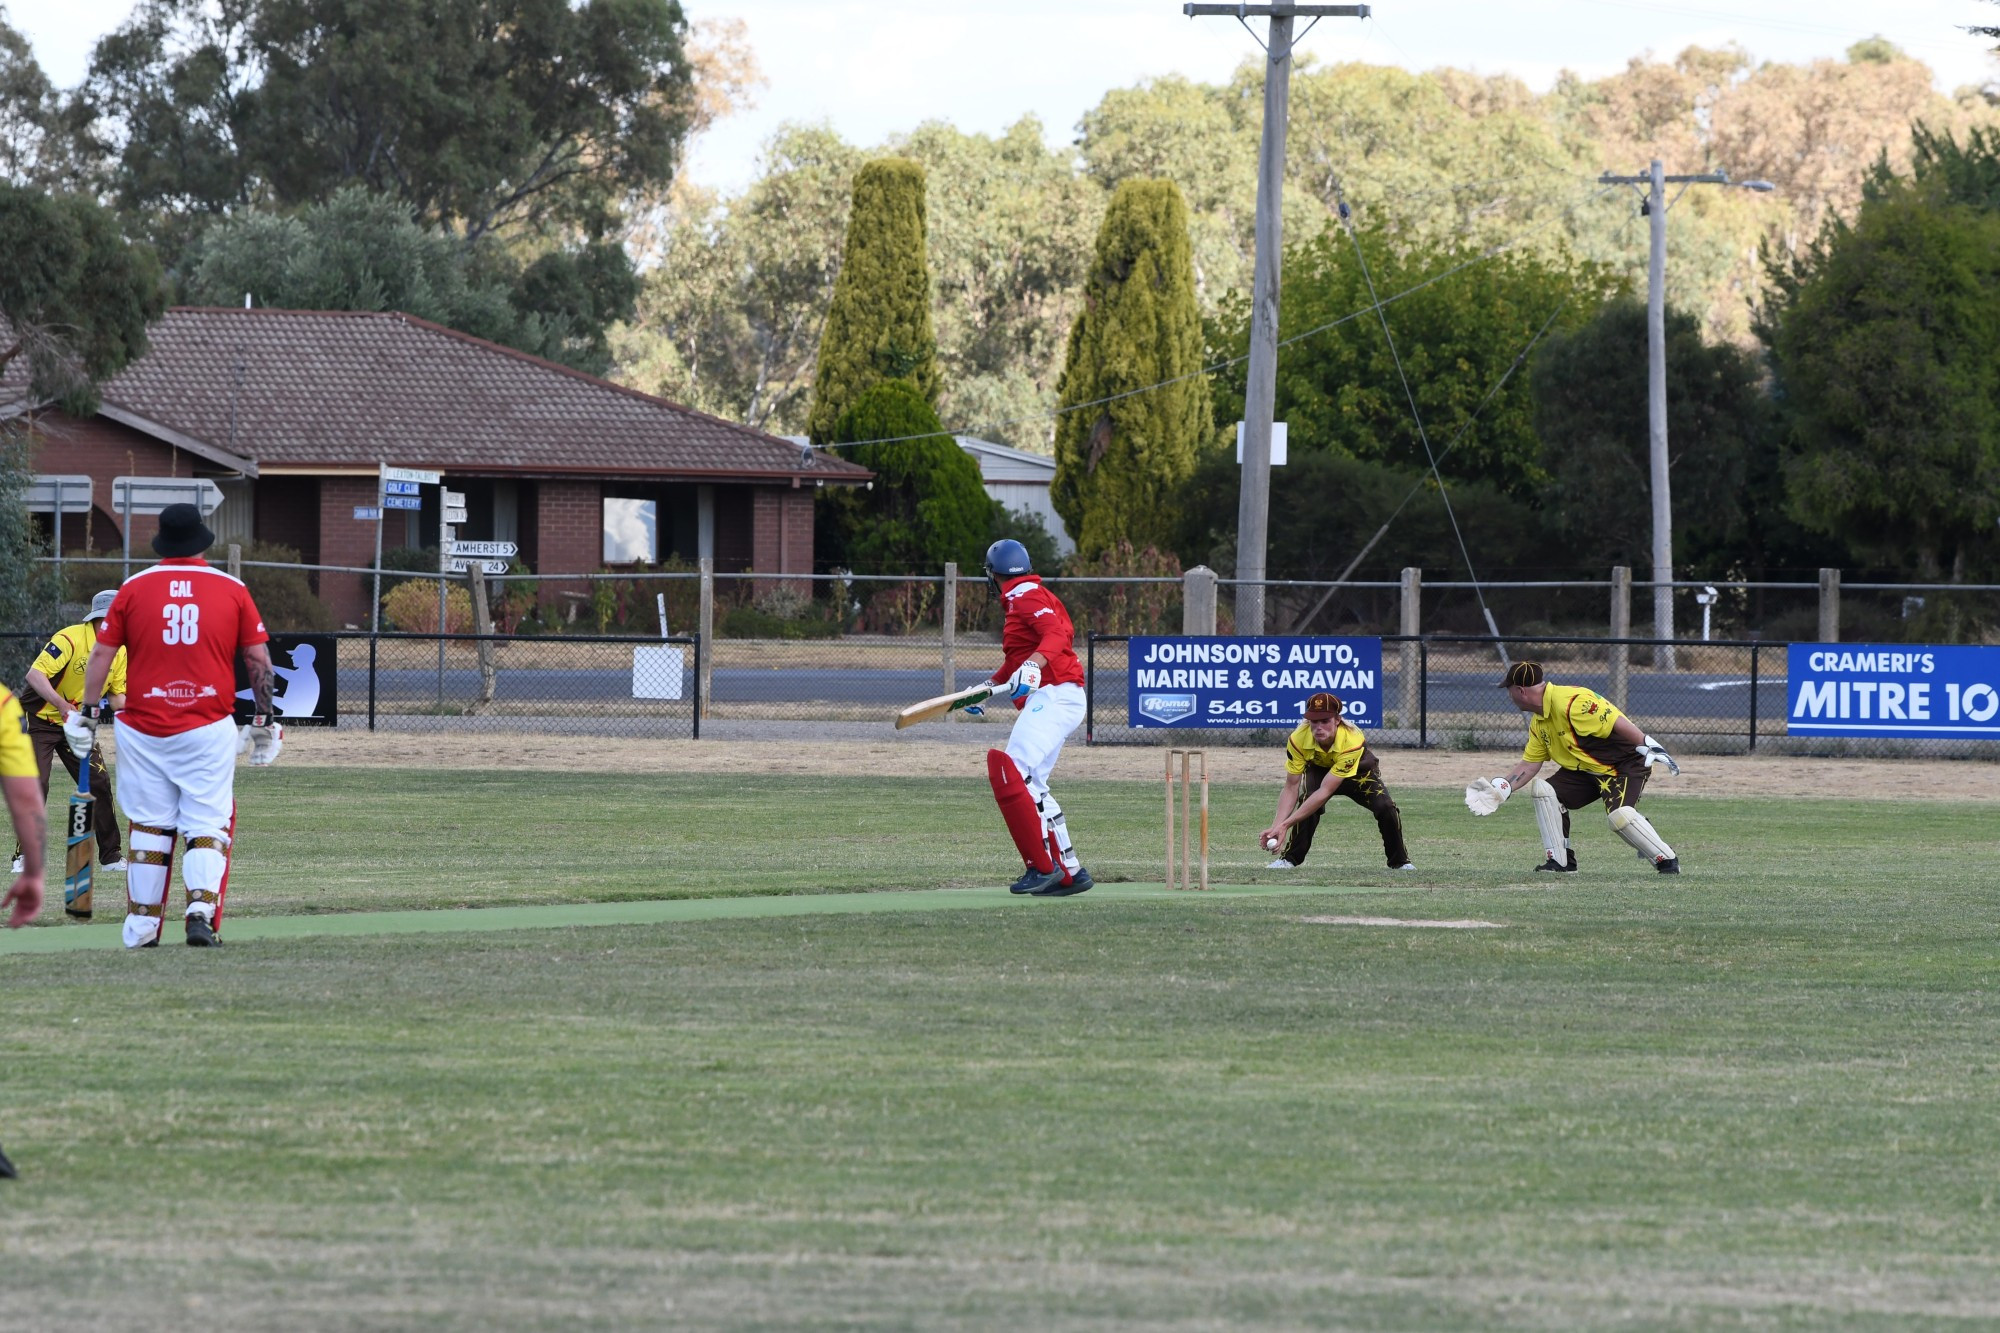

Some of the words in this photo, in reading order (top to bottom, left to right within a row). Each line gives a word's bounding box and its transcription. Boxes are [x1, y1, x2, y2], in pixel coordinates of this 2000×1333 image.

[388, 482, 402, 493] GOLF
[404, 483, 419, 494] CLUB
[387, 497, 420, 508] CEMETERY
[456, 543, 499, 554] AMHERST
[502, 544, 508, 554] 5
[488, 562, 499, 572] 24
[169, 580, 194, 598] CAL
[162, 603, 200, 646] 38
[1144, 644, 1281, 664] JOHNSON'S
[1287, 645, 1360, 668] AUTO,
[1809, 652, 1935, 674] CRAMERI'S
[1137, 669, 1229, 689] MARINE
[1236, 670, 1254, 689] &
[1261, 670, 1374, 690] CARAVAN
[167, 688, 195, 698] MILLS
[1144, 697, 1190, 710] Roma
[1208, 700, 1278, 715] 5461
[1793, 681, 1931, 720] MITRE
[1945, 683, 1999, 722] 10
[73, 801, 88, 837] ICON
